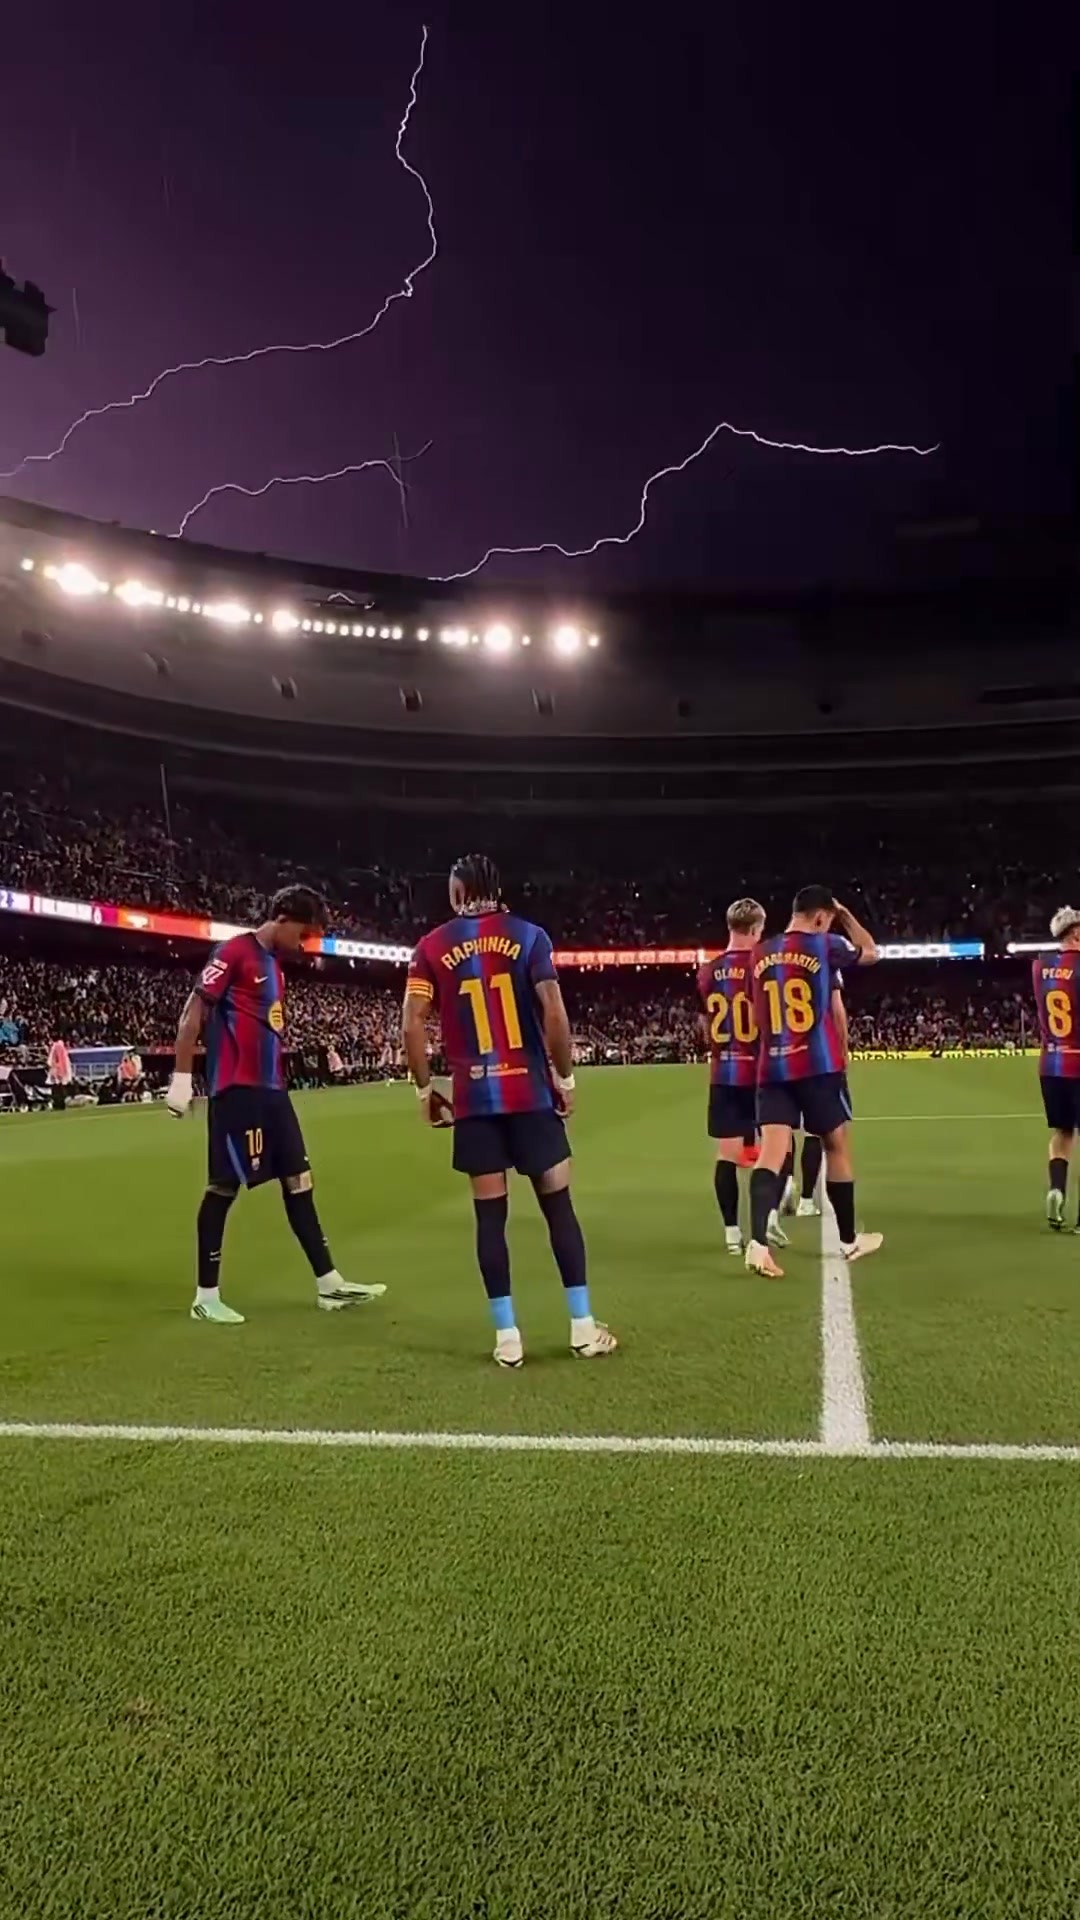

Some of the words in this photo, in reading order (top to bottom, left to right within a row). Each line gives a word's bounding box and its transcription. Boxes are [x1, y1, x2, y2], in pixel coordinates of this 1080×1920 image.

[441, 936, 522, 970] RAPHINHA
[1042, 967, 1073, 980] PEDRI
[458, 973, 523, 1055] 11
[707, 991, 758, 1043] 20
[763, 978, 815, 1034] 18
[1046, 990, 1072, 1038] 8
[245, 1128, 263, 1156] 10
